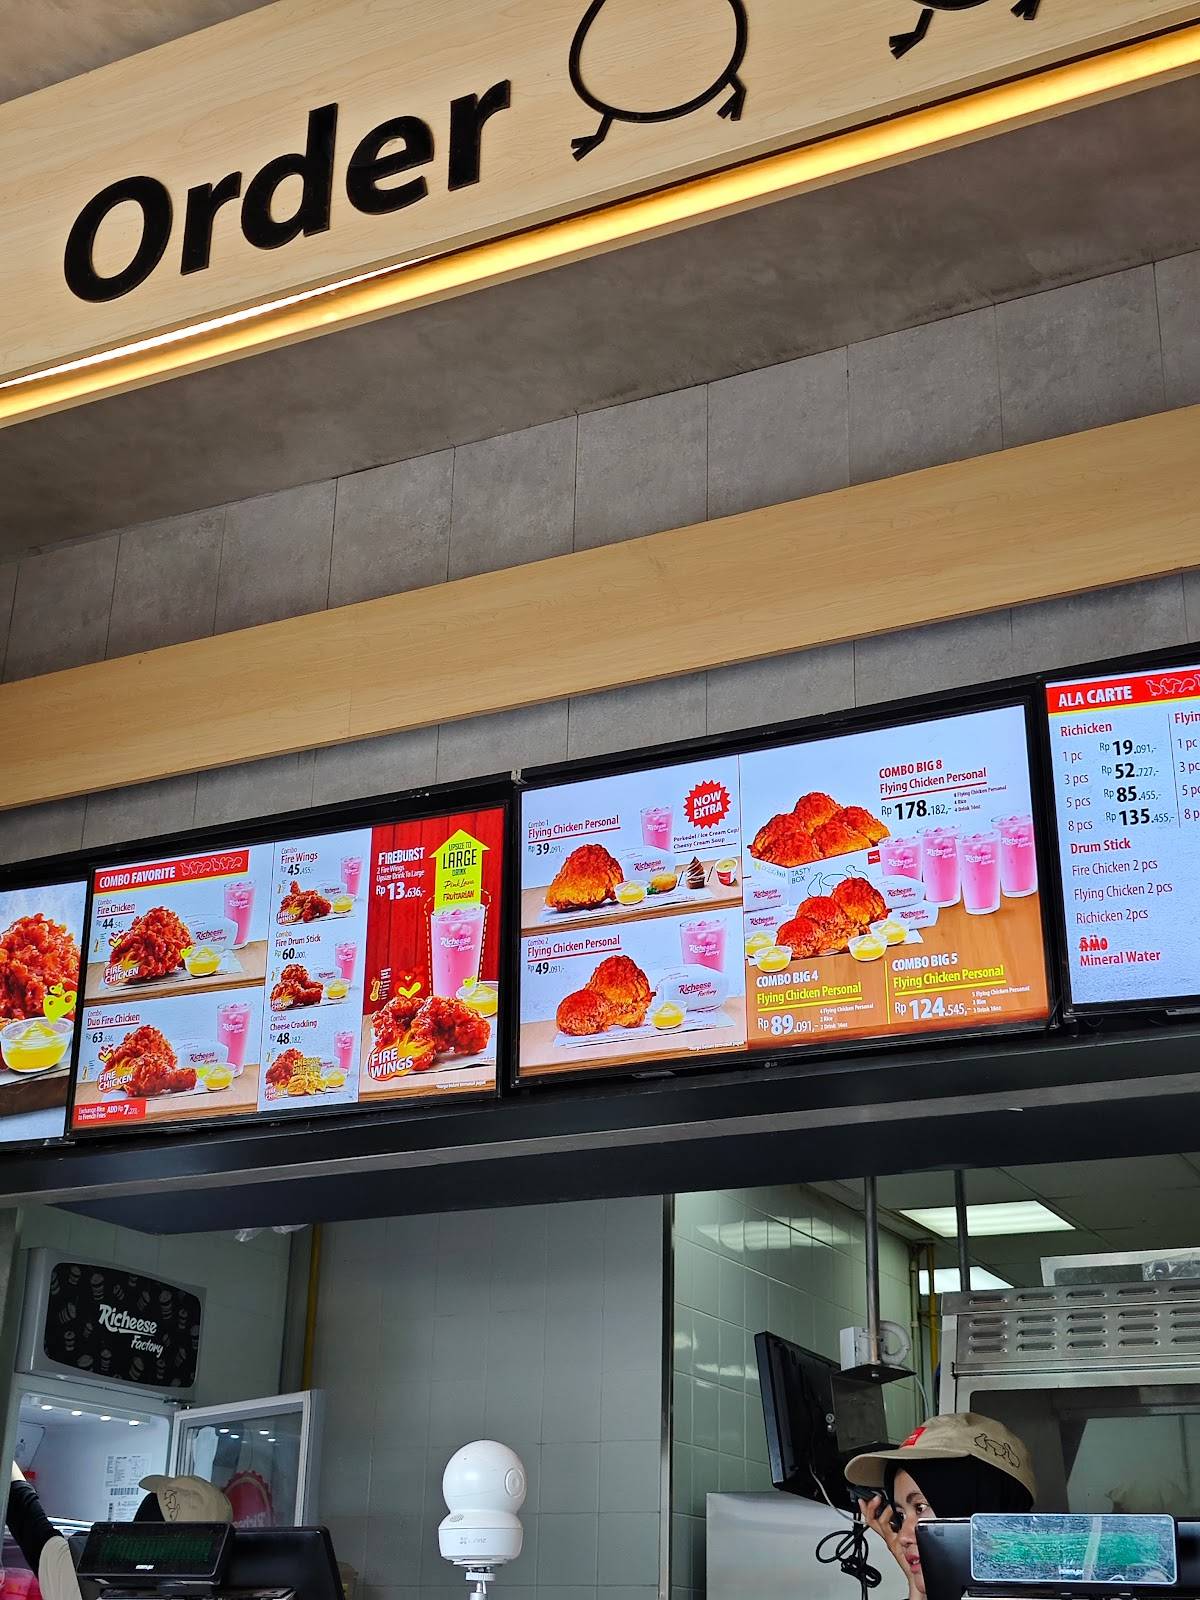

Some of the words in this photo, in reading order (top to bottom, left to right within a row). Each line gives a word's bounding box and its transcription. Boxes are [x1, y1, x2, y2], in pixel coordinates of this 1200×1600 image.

[64, 79, 511, 303] Order
[1059, 692, 1084, 707] ALA
[1087, 686, 1132, 704] CARTE
[1060, 722, 1112, 737] Richicken
[1100, 742, 1110, 752] Rp
[1186, 739, 1198, 751] pc
[1063, 752, 1067, 761] 1
[1071, 752, 1082, 764] pc
[879, 764, 914, 778] COMBO
[917, 761, 934, 772] BIG
[936, 760, 942, 769] 8
[1102, 766, 1112, 776] Rp
[1180, 762, 1185, 772] 3
[880, 781, 907, 795] Flying
[910, 774, 944, 788] Chicken
[946, 767, 986, 782] Personal
[1065, 775, 1070, 784] 3
[1073, 774, 1088, 787] pcs
[1104, 789, 1114, 799] Rp
[1182, 784, 1188, 796] 5
[694, 790, 721, 808] NOW
[1067, 798, 1072, 808] 5
[1075, 797, 1090, 810] pcs
[694, 802, 722, 820] EXTRA
[882, 806, 892, 816] Rp
[1106, 812, 1116, 822] Rp
[1184, 809, 1190, 819] 8
[528, 828, 552, 839] Flying
[554, 822, 583, 834] Chicken
[585, 815, 619, 829] Personal
[1068, 821, 1074, 831] 8
[1077, 820, 1092, 832] pcs
[674, 842, 692, 850] Cheesy
[711, 838, 725, 846] Soup
[1070, 843, 1100, 854] Drum
[1104, 838, 1131, 851] Stick
[281, 854, 294, 864] Fire
[295, 852, 318, 863] Wings
[378, 847, 425, 865] FIREBURST
[442, 848, 477, 869] LARGE
[792, 867, 811, 877] TASTY
[1072, 865, 1090, 876] Fire
[1092, 861, 1130, 875] Chicken
[1133, 860, 1139, 870] 2
[1142, 860, 1158, 872] pcs
[100, 874, 129, 888] COMBO
[131, 867, 175, 883] FAVORITE
[792, 876, 806, 884] BOX
[376, 885, 386, 896] Rp
[1074, 888, 1104, 902] Flying
[1106, 884, 1144, 897] Chicken
[1148, 882, 1153, 894] 2
[1156, 882, 1172, 896] pcs
[97, 906, 110, 915] Fire
[110, 902, 135, 913] Chicken
[1076, 910, 1123, 924] Richicken
[1126, 908, 1148, 922] 2pcs
[275, 939, 287, 947] Fire
[288, 937, 305, 946] Drum
[306, 934, 321, 943] Stick
[527, 946, 552, 958] Flying
[553, 942, 584, 953] Chicken
[586, 934, 620, 948] Personal
[892, 956, 928, 971] COMBO
[931, 954, 949, 967] BIG
[950, 953, 958, 964] 5
[1080, 952, 1123, 966] Mineral
[1126, 951, 1160, 963] Water
[105, 967, 139, 984] CHICKEN
[106, 964, 122, 976] FIRE
[894, 976, 922, 990] Flying
[923, 972, 961, 984] Chicken
[962, 965, 1004, 980] Personal
[757, 973, 790, 987] COMBO
[792, 971, 810, 983] BIG
[811, 970, 818, 981] 4
[678, 982, 712, 994] Richeese
[757, 992, 784, 1006] Flying
[786, 988, 820, 1001] Chicken
[822, 981, 861, 996] Personal
[895, 1002, 906, 1016] Rp
[87, 1017, 100, 1027] Duo
[102, 1016, 114, 1025] Fire
[115, 1013, 140, 1023] Chicken
[270, 1023, 290, 1031] Cheese
[758, 1018, 769, 1031] Rp
[770, 1014, 818, 1035] 89.091,-
[372, 1048, 398, 1066] FIRE
[370, 1056, 413, 1078] WINGS
[98, 1074, 134, 1091] CHICKEN
[100, 1071, 115, 1083] FIRE
[98, 1304, 158, 1336] Richeese
[130, 1335, 164, 1358] Factory
